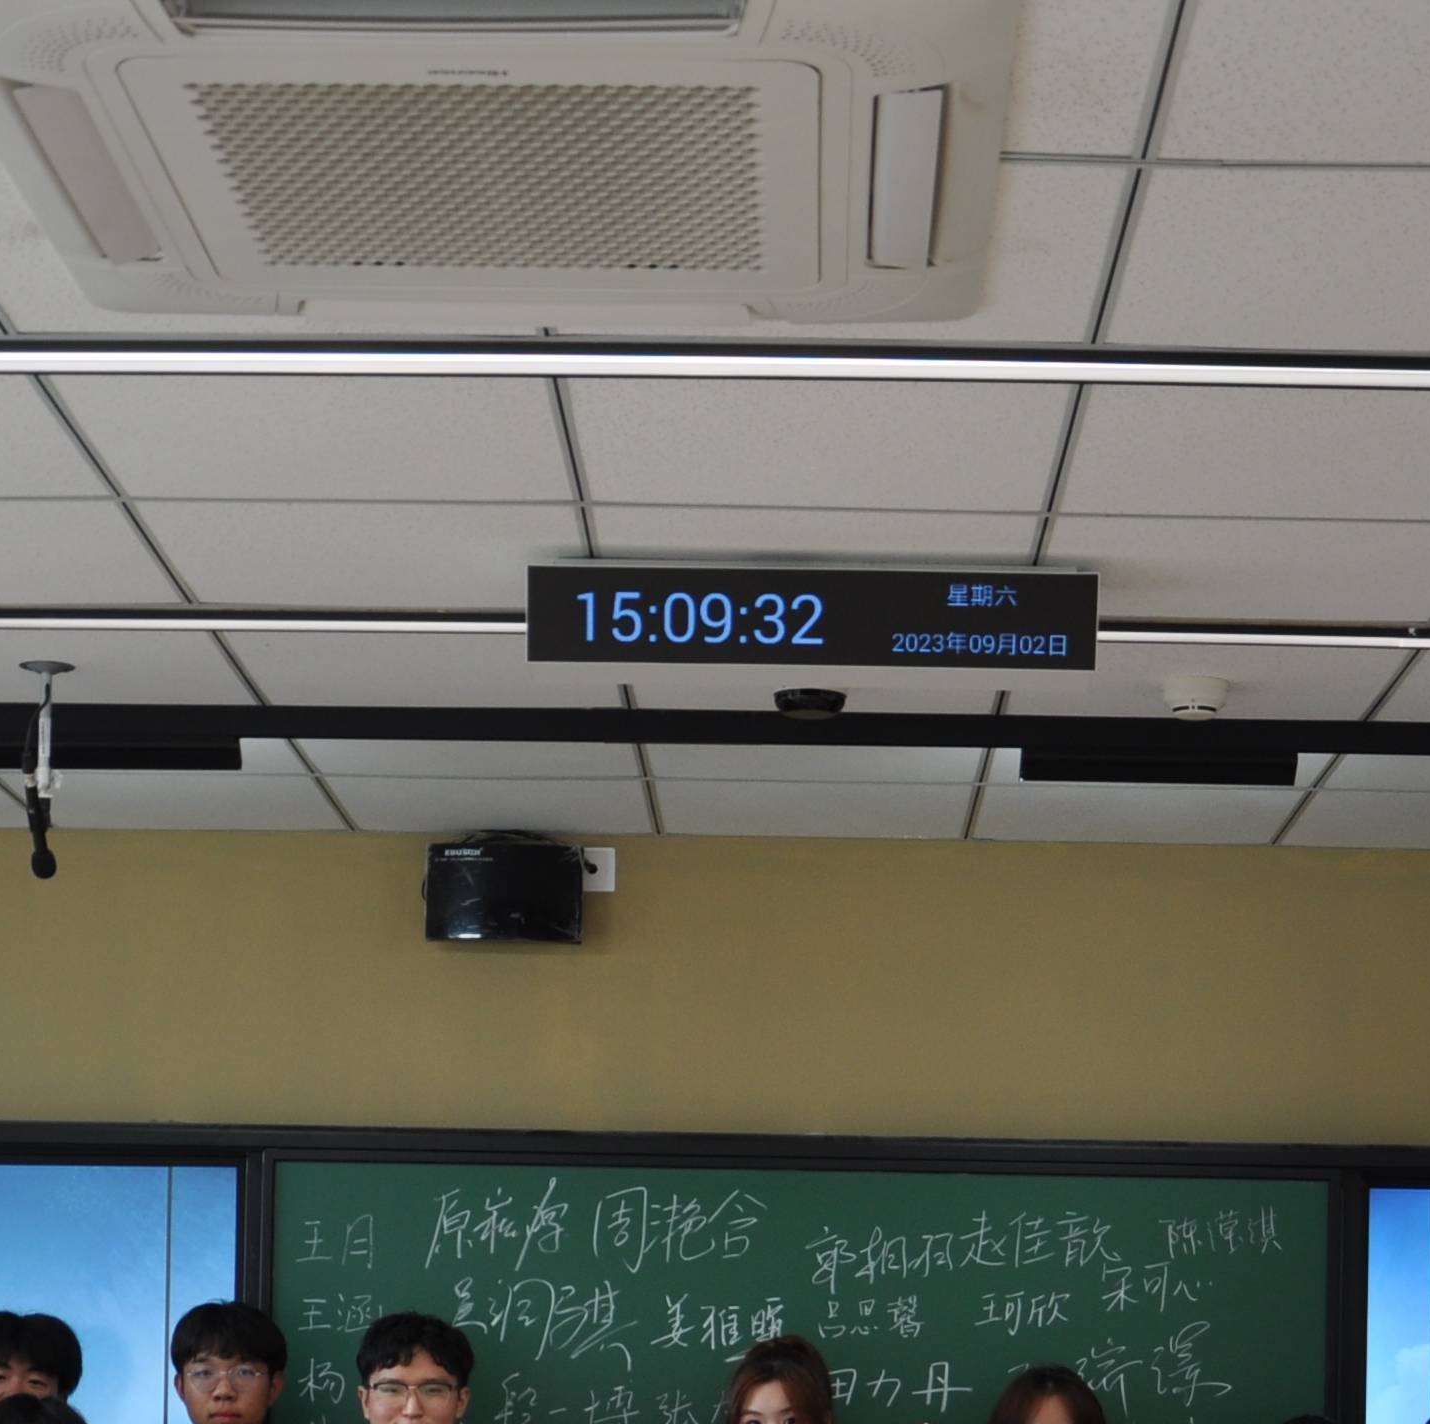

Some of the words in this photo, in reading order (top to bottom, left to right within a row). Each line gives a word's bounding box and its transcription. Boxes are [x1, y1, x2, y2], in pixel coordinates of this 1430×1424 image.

[946, 583, 1019, 609] 星期六
[576, 590, 825, 646] 15:09:32
[891, 630, 1069, 658] 2023年09月02日
